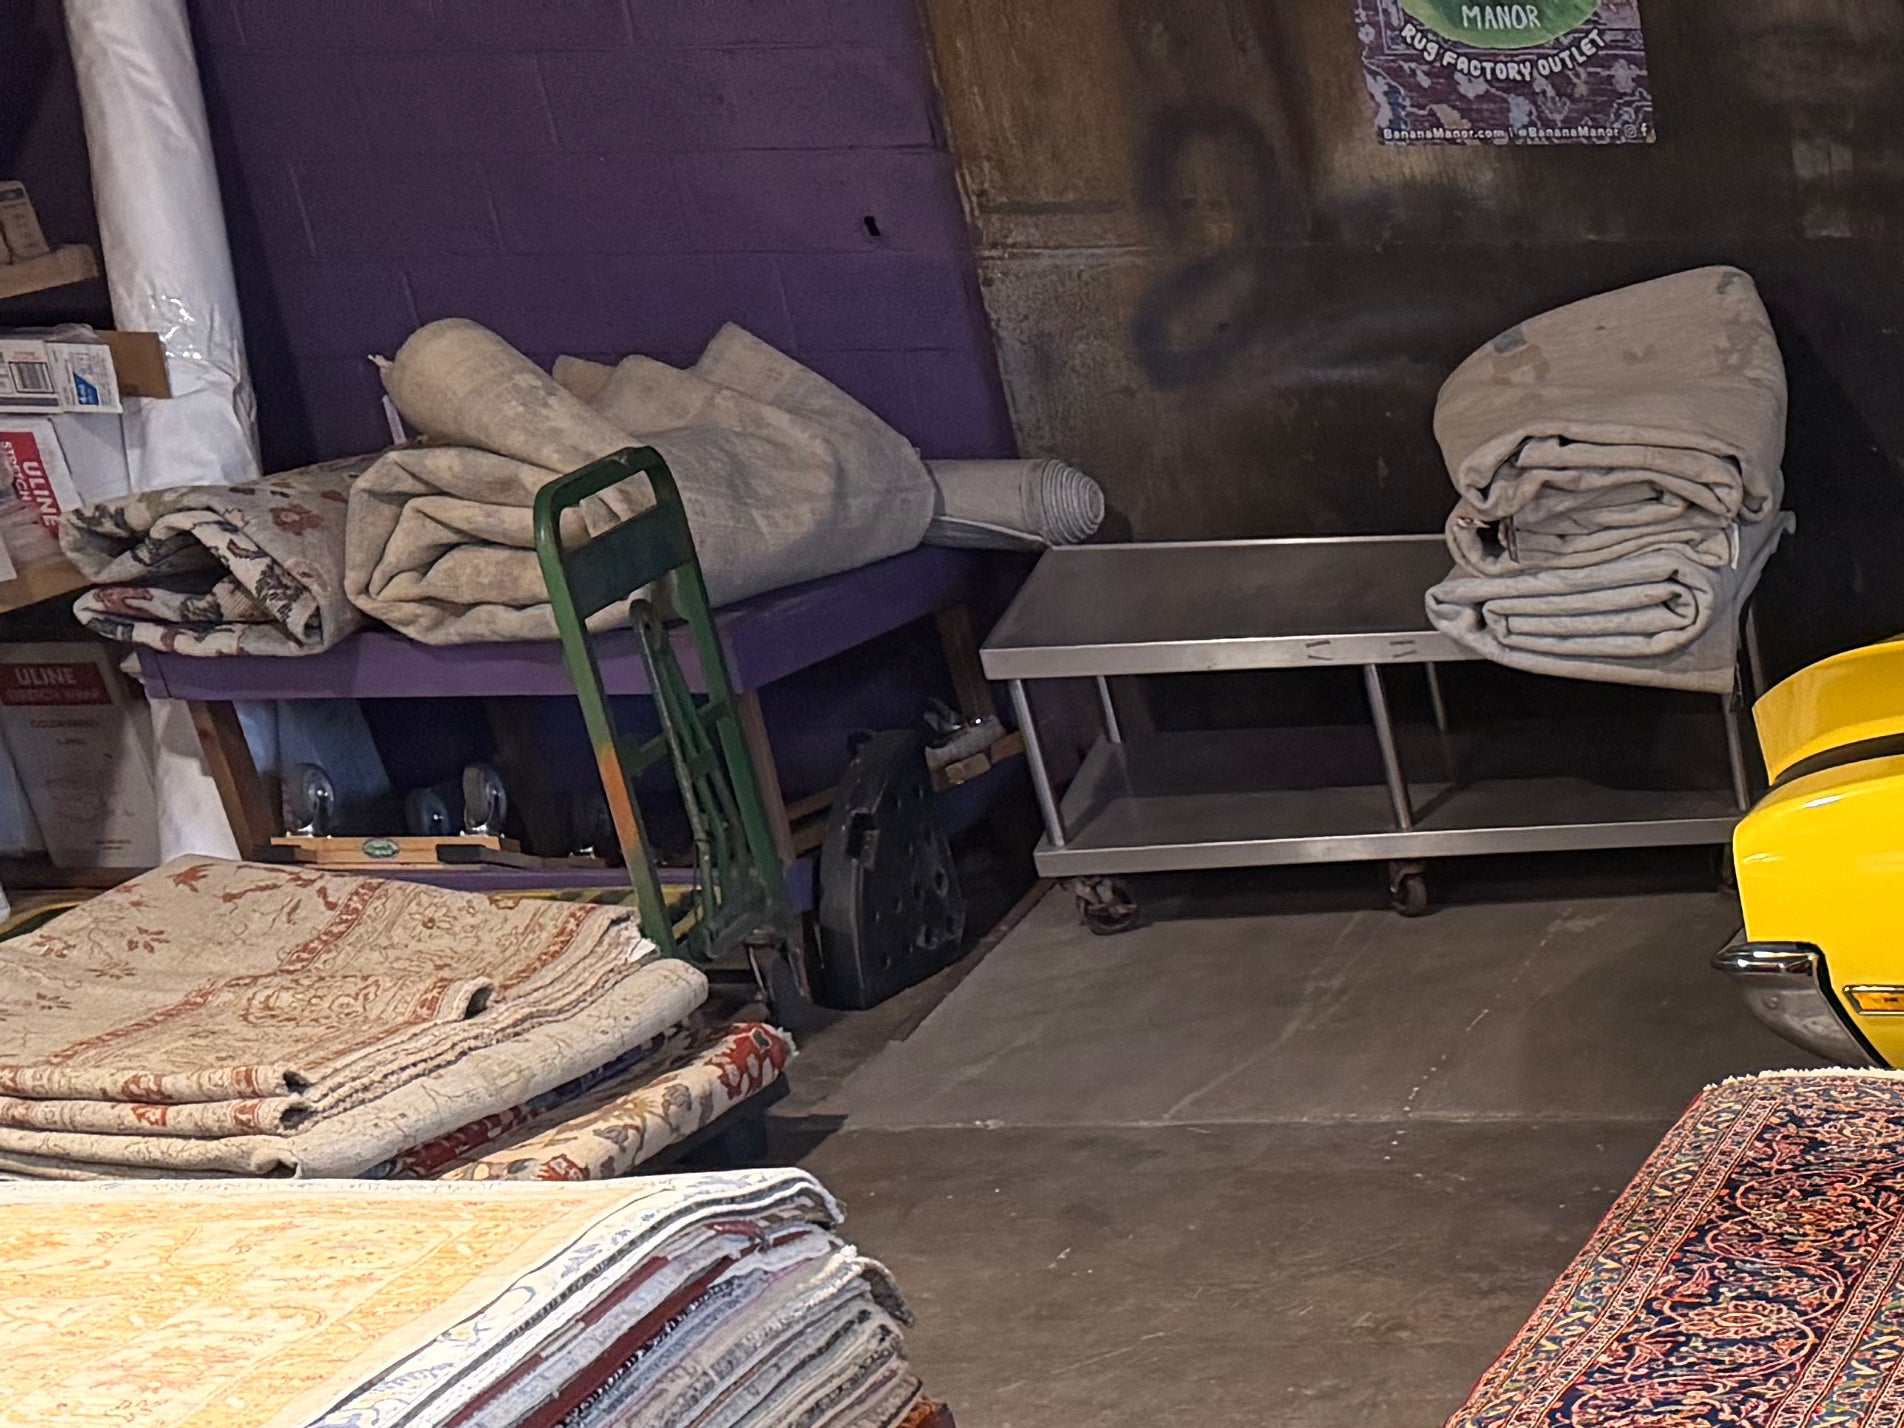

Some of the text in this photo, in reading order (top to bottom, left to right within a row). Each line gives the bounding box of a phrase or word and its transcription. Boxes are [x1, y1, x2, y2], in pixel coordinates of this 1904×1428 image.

[1461, 4, 1541, 30] MANOR
[1442, 50, 1532, 81] FACTORY
[1537, 28, 1606, 76] OUTLET
[1383, 128, 1507, 140] BananaManor.com
[24, 460, 60, 528] ULINE
[14, 667, 77, 685] ULINE
